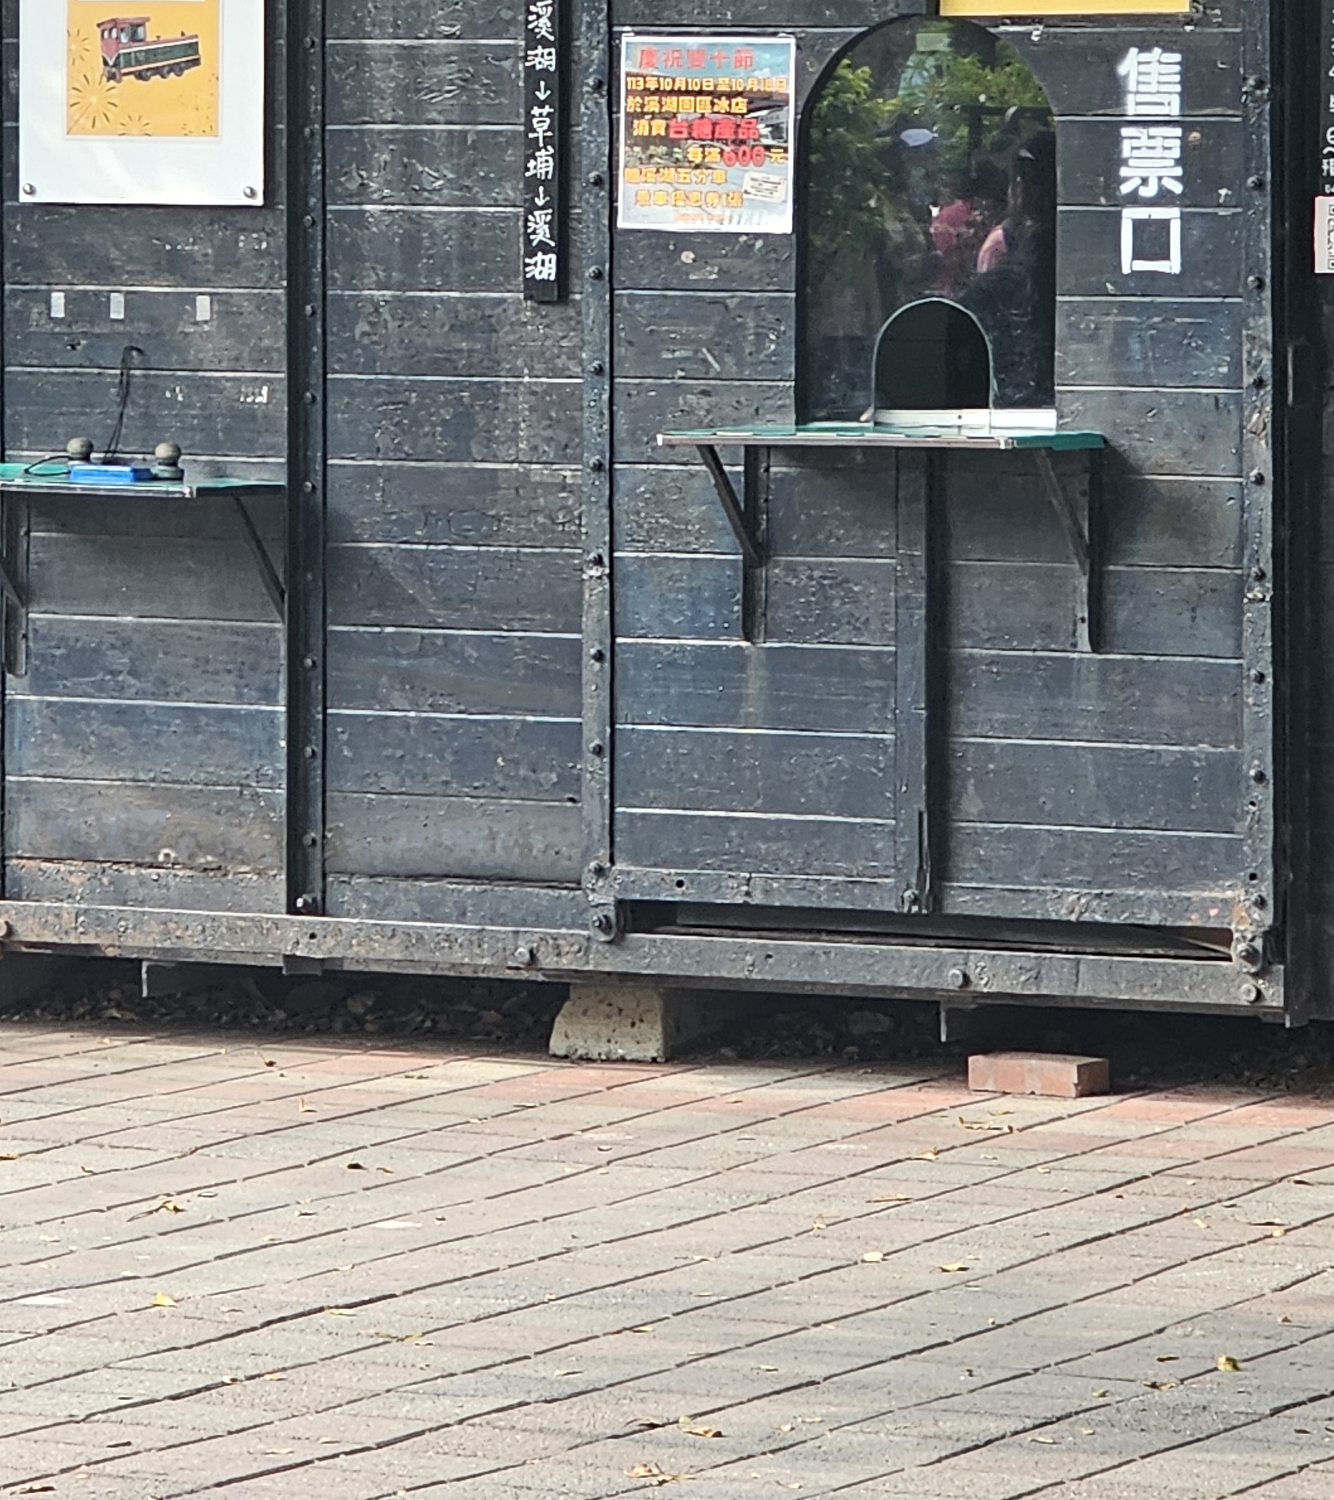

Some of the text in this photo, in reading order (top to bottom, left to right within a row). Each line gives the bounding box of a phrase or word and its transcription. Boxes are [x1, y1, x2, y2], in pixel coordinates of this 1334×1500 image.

[639, 47, 754, 70] 慶祝雙十節
[1118, 47, 1184, 275] 售票口
